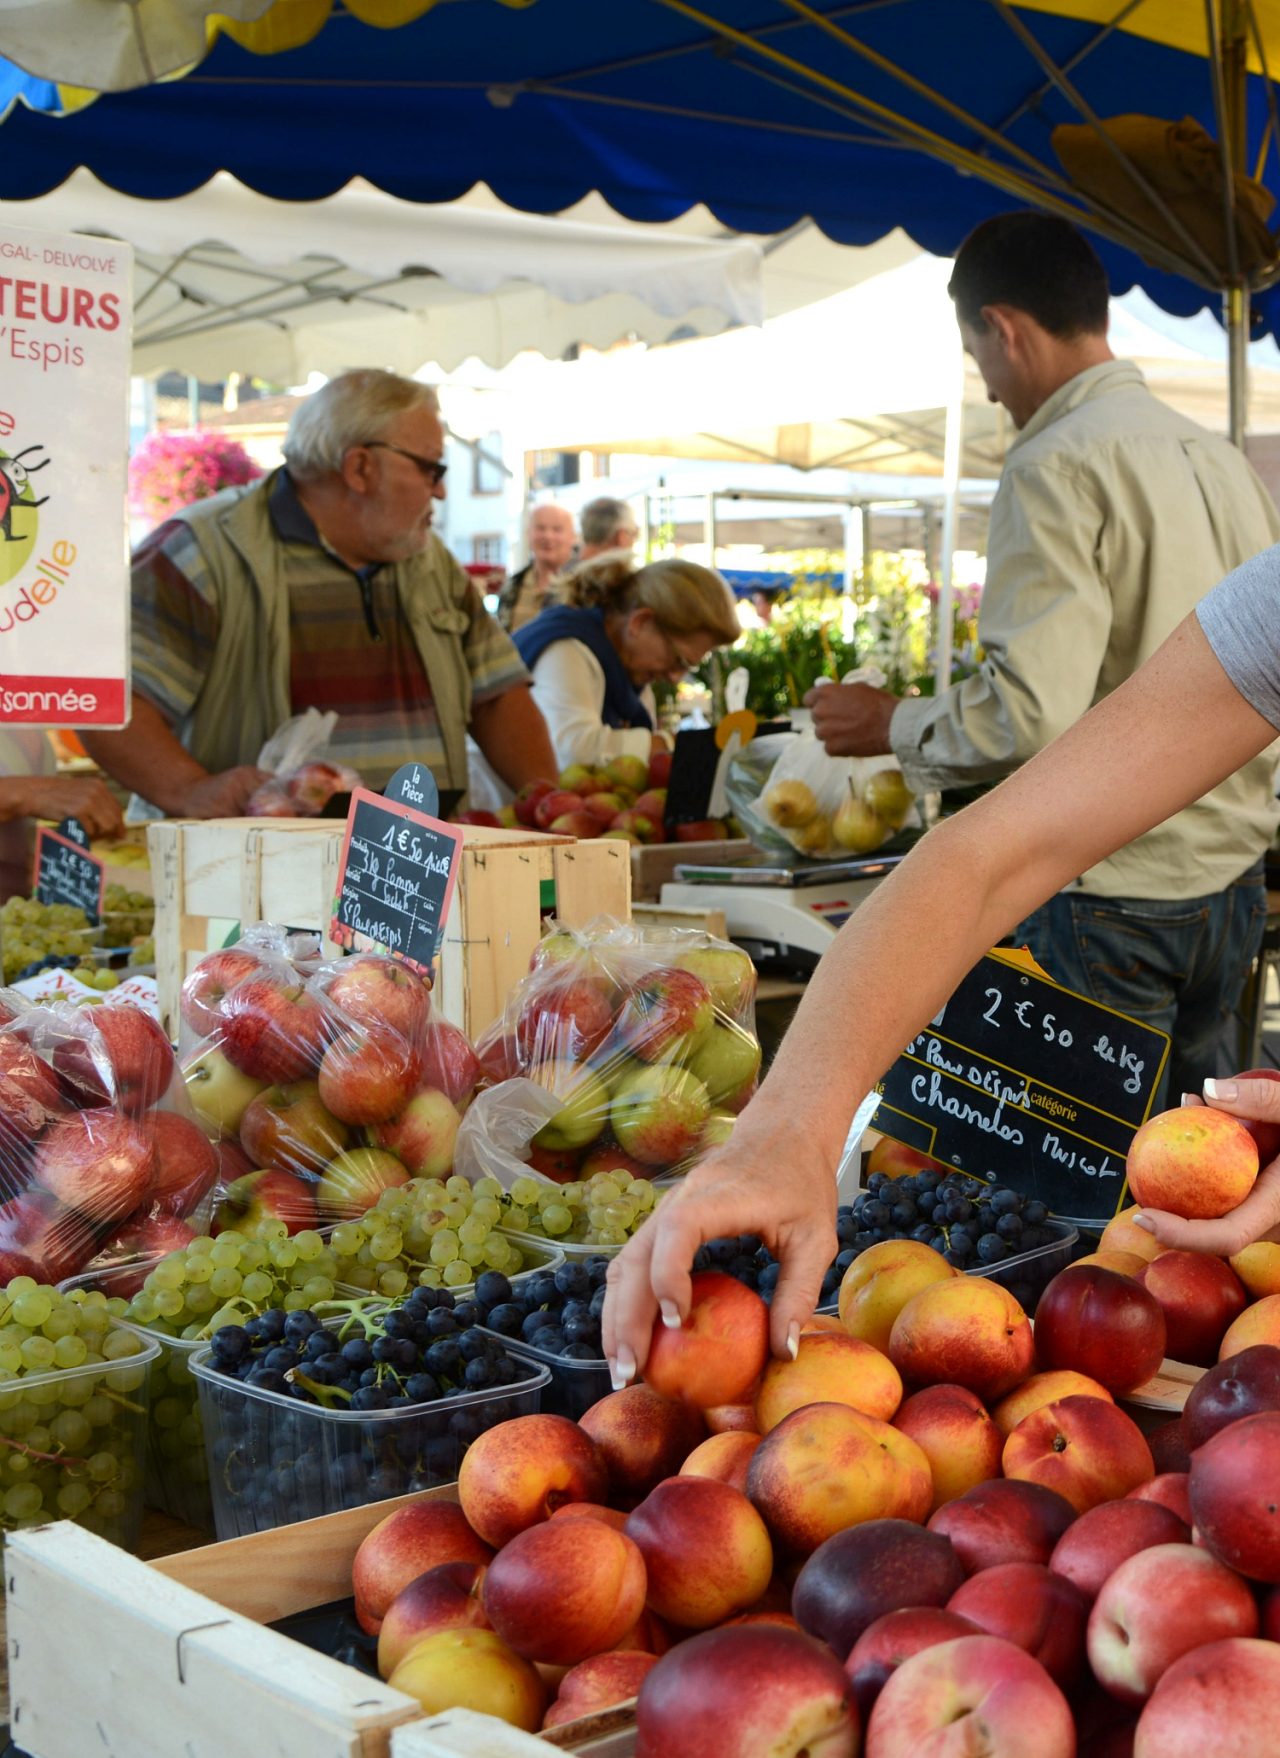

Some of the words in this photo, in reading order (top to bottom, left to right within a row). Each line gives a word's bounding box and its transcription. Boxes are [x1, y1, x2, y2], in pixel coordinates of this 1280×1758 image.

[43, 249, 116, 274] DELVOLVÉ
[401, 779, 424, 804] Pièce
[982, 988, 1002, 1028] 2
[1014, 1001, 1034, 1029] €
[1042, 1014, 1073, 1047] 50
